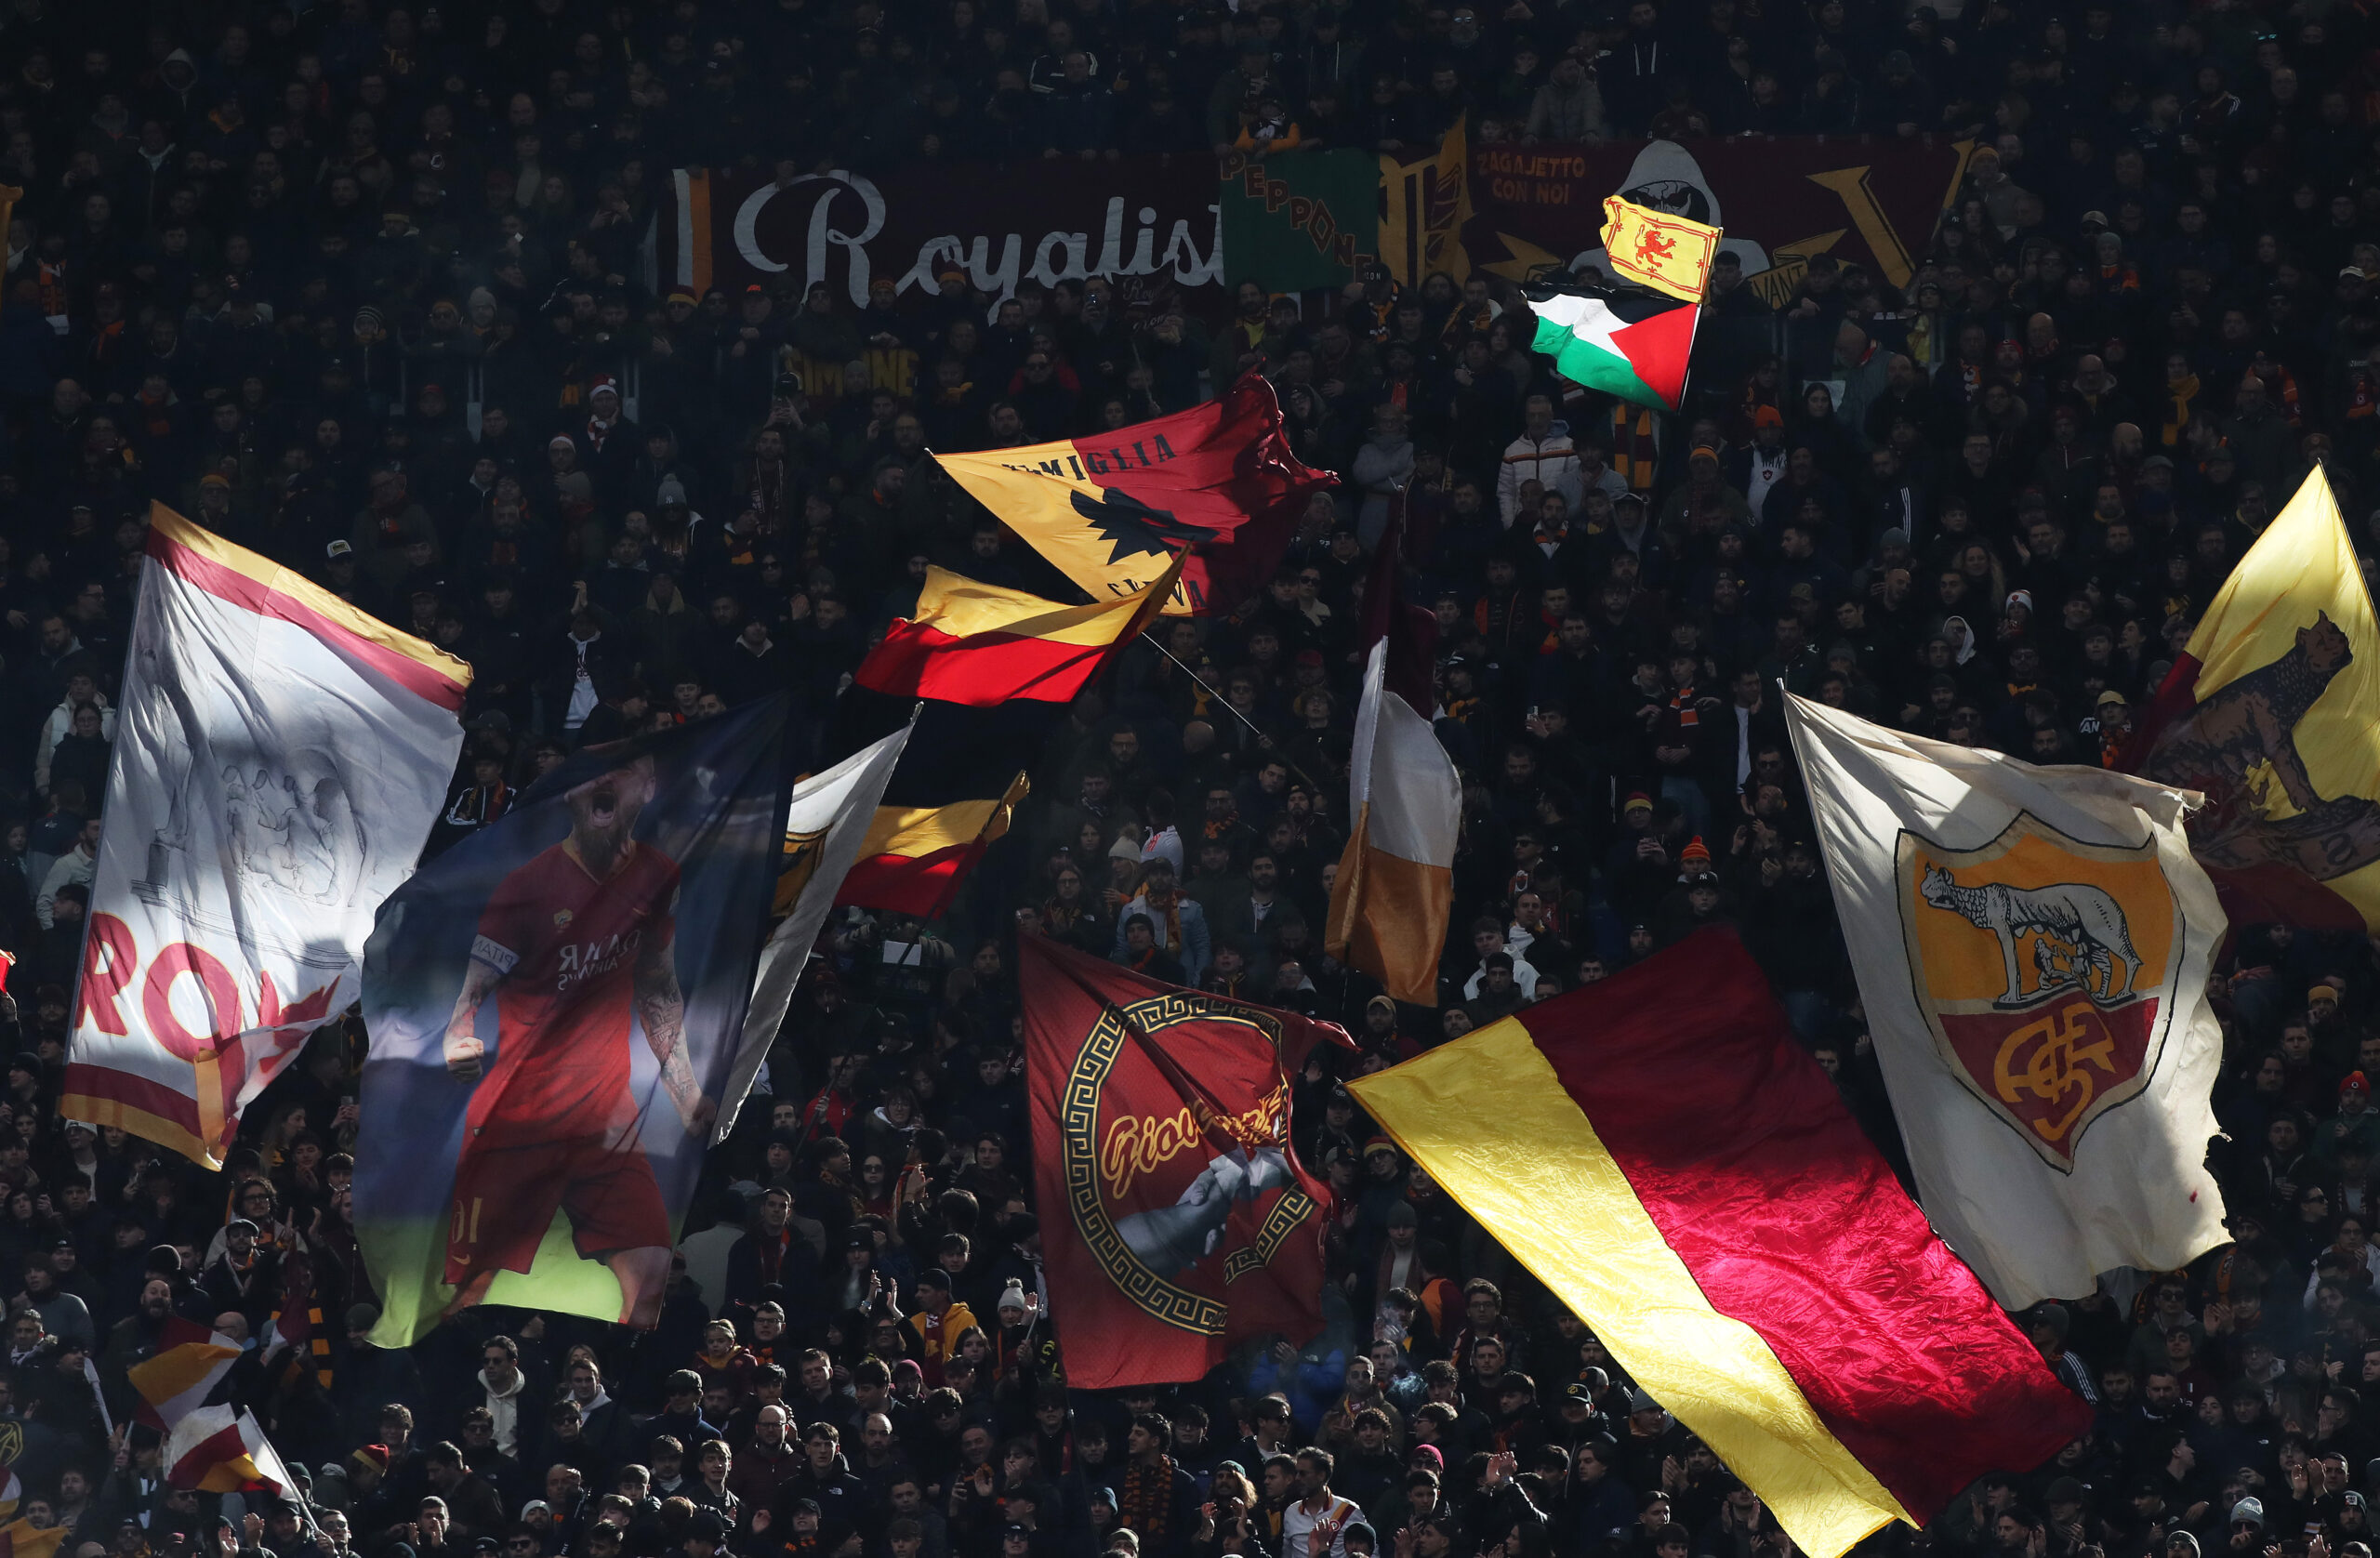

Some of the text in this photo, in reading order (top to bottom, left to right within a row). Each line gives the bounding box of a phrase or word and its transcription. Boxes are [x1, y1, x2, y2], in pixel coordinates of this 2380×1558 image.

[1492, 178, 1570, 205] CON NOI
[785, 348, 919, 398] SIMNE
[1001, 434, 1177, 481] MIGLIA
[73, 910, 341, 1066] RO
